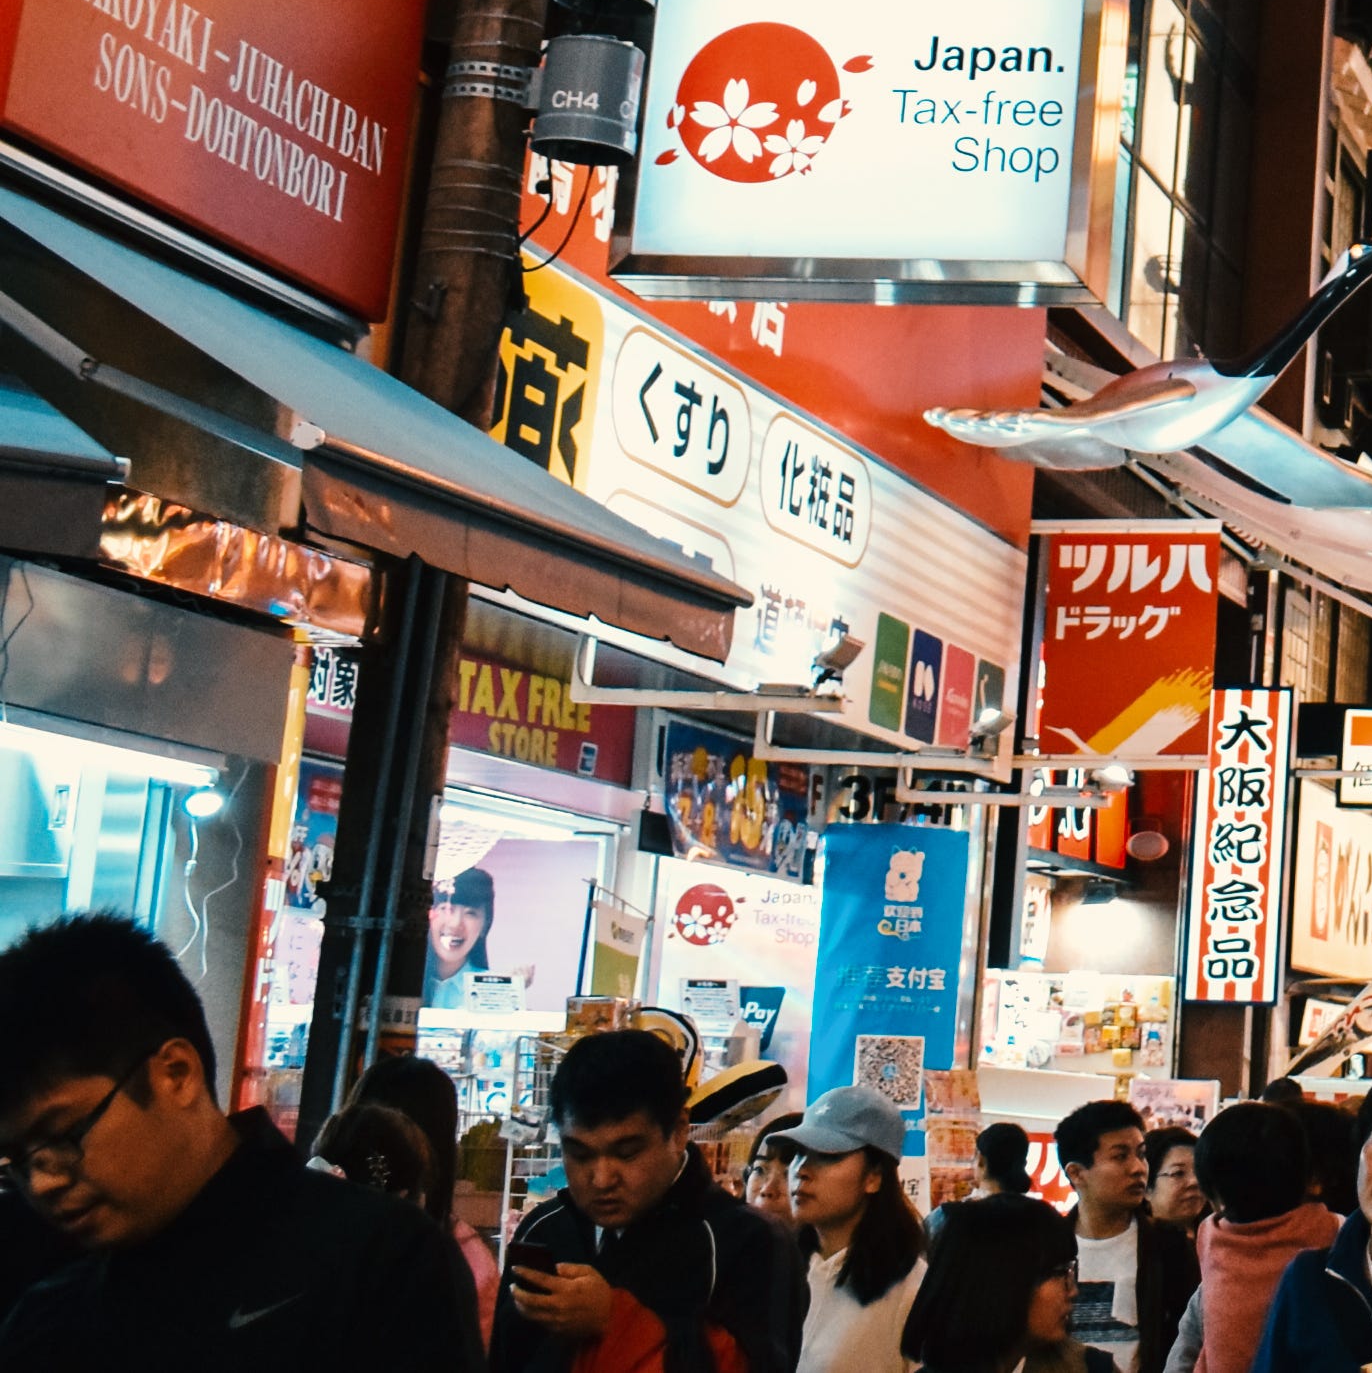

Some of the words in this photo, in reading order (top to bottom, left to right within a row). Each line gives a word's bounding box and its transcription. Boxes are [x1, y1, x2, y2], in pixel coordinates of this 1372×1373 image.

[915, 36, 1066, 79] Japan.
[552, 90, 598, 110] CH4
[893, 88, 1063, 126] Tax-free
[952, 137, 1059, 182] Shop
[640, 363, 730, 476] くすり
[779, 440, 855, 546] 化粧品
[1059, 544, 1212, 593] ツルハ
[1055, 606, 1181, 640] ドラッグ
[458, 659, 522, 721] TAX
[528, 673, 591, 733] FREE
[488, 721, 558, 767] STORE
[1205, 710, 1273, 981] 大阪紀念品
[761, 890, 816, 904] Japan.
[775, 927, 814, 945] Shop
